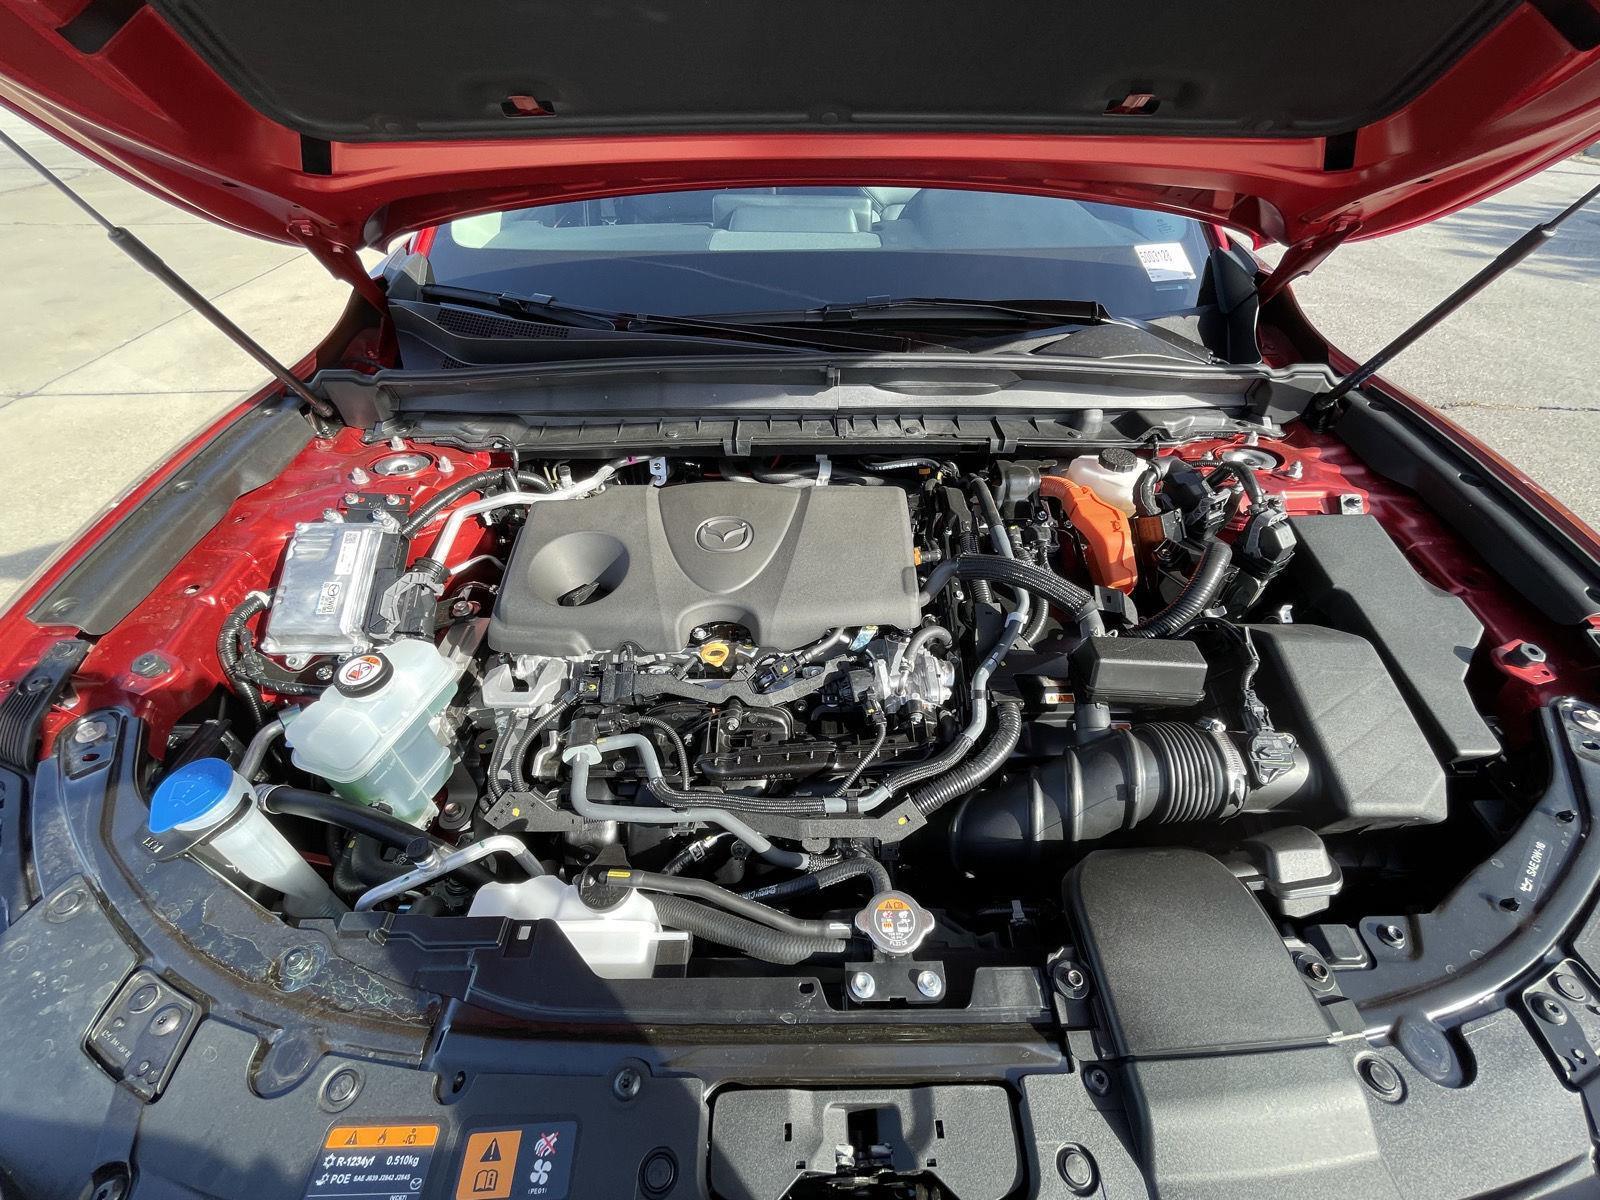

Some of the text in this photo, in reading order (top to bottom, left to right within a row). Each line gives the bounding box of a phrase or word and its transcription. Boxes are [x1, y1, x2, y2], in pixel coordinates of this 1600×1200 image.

[1526, 860, 1540, 877] SAE
[336, 1155, 420, 1169] R-1234yf 0.510kg
[330, 1173, 352, 1185] POE
